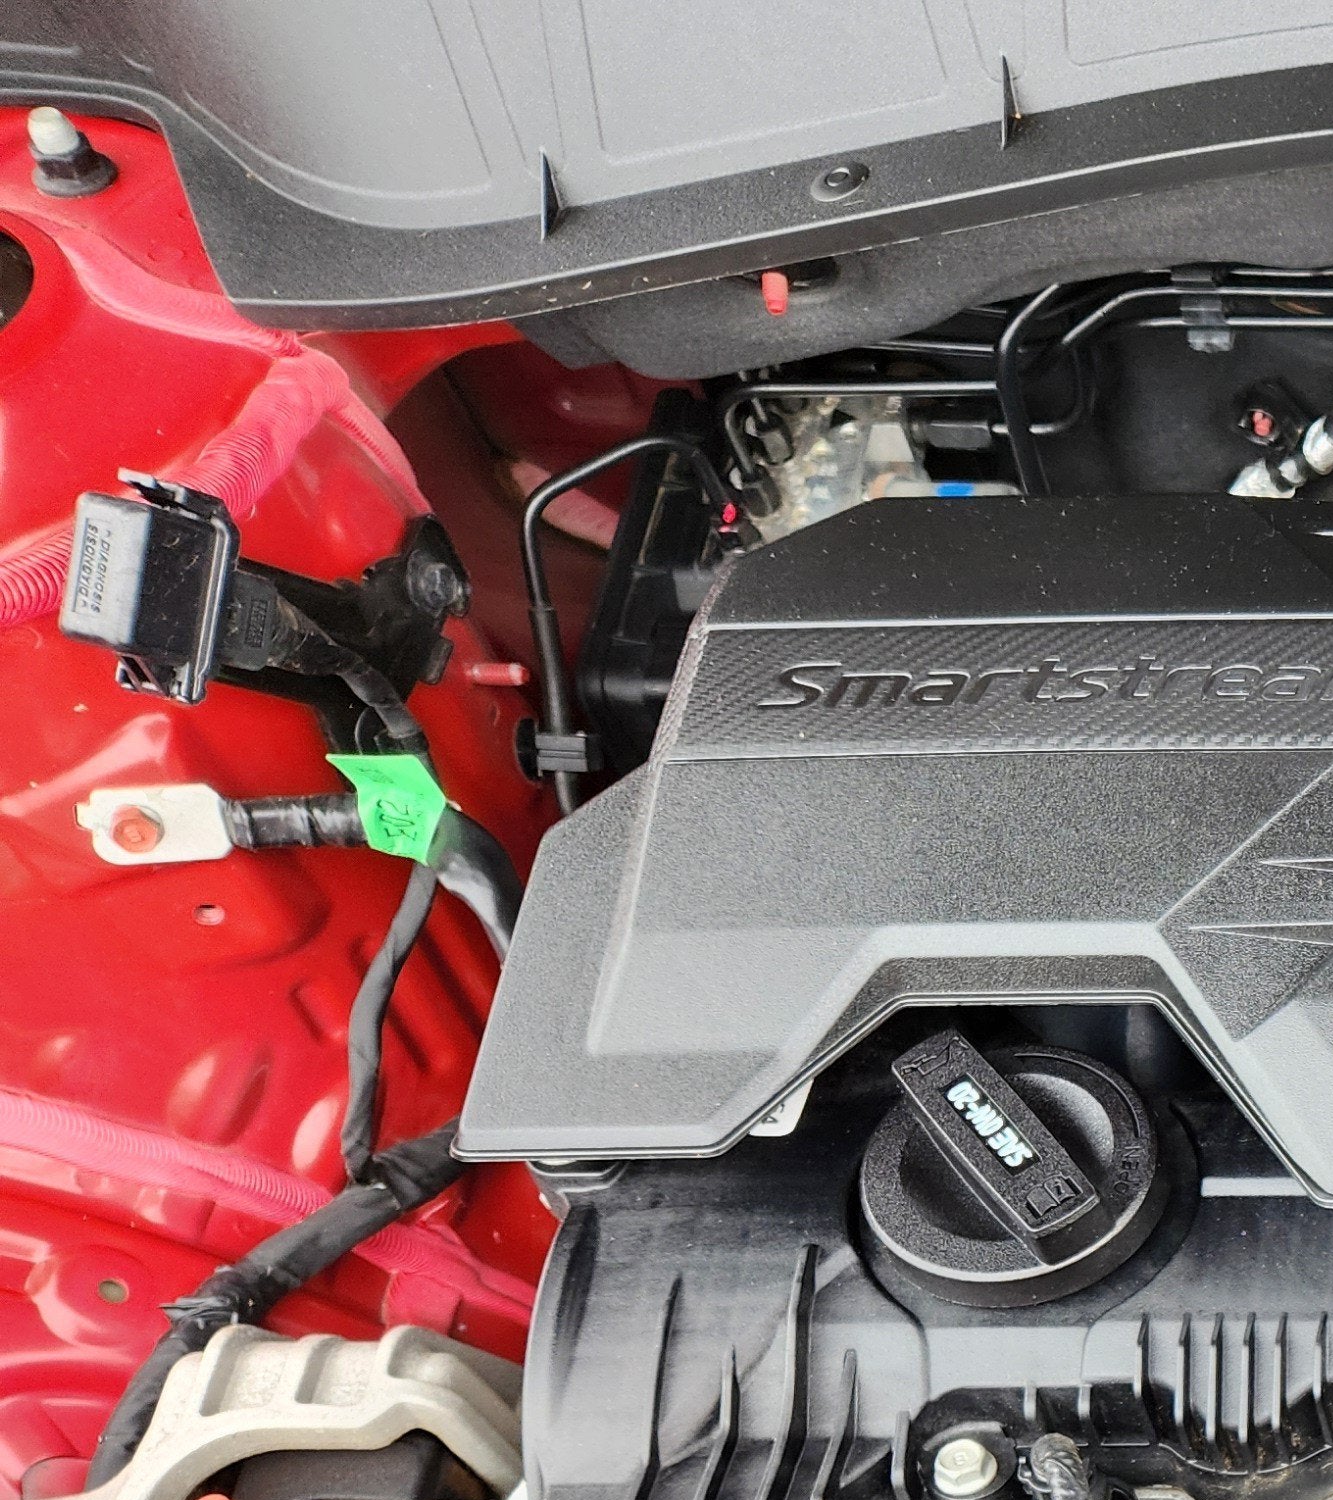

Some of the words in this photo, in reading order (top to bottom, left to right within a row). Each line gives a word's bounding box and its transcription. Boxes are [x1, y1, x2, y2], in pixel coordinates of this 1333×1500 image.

[79, 524, 99, 597] DIAGNOSIS
[90, 539, 111, 613] DIAGNOSIS
[986, 1125, 1034, 1168] SAE
[1112, 1144, 1143, 1196] OPEN
